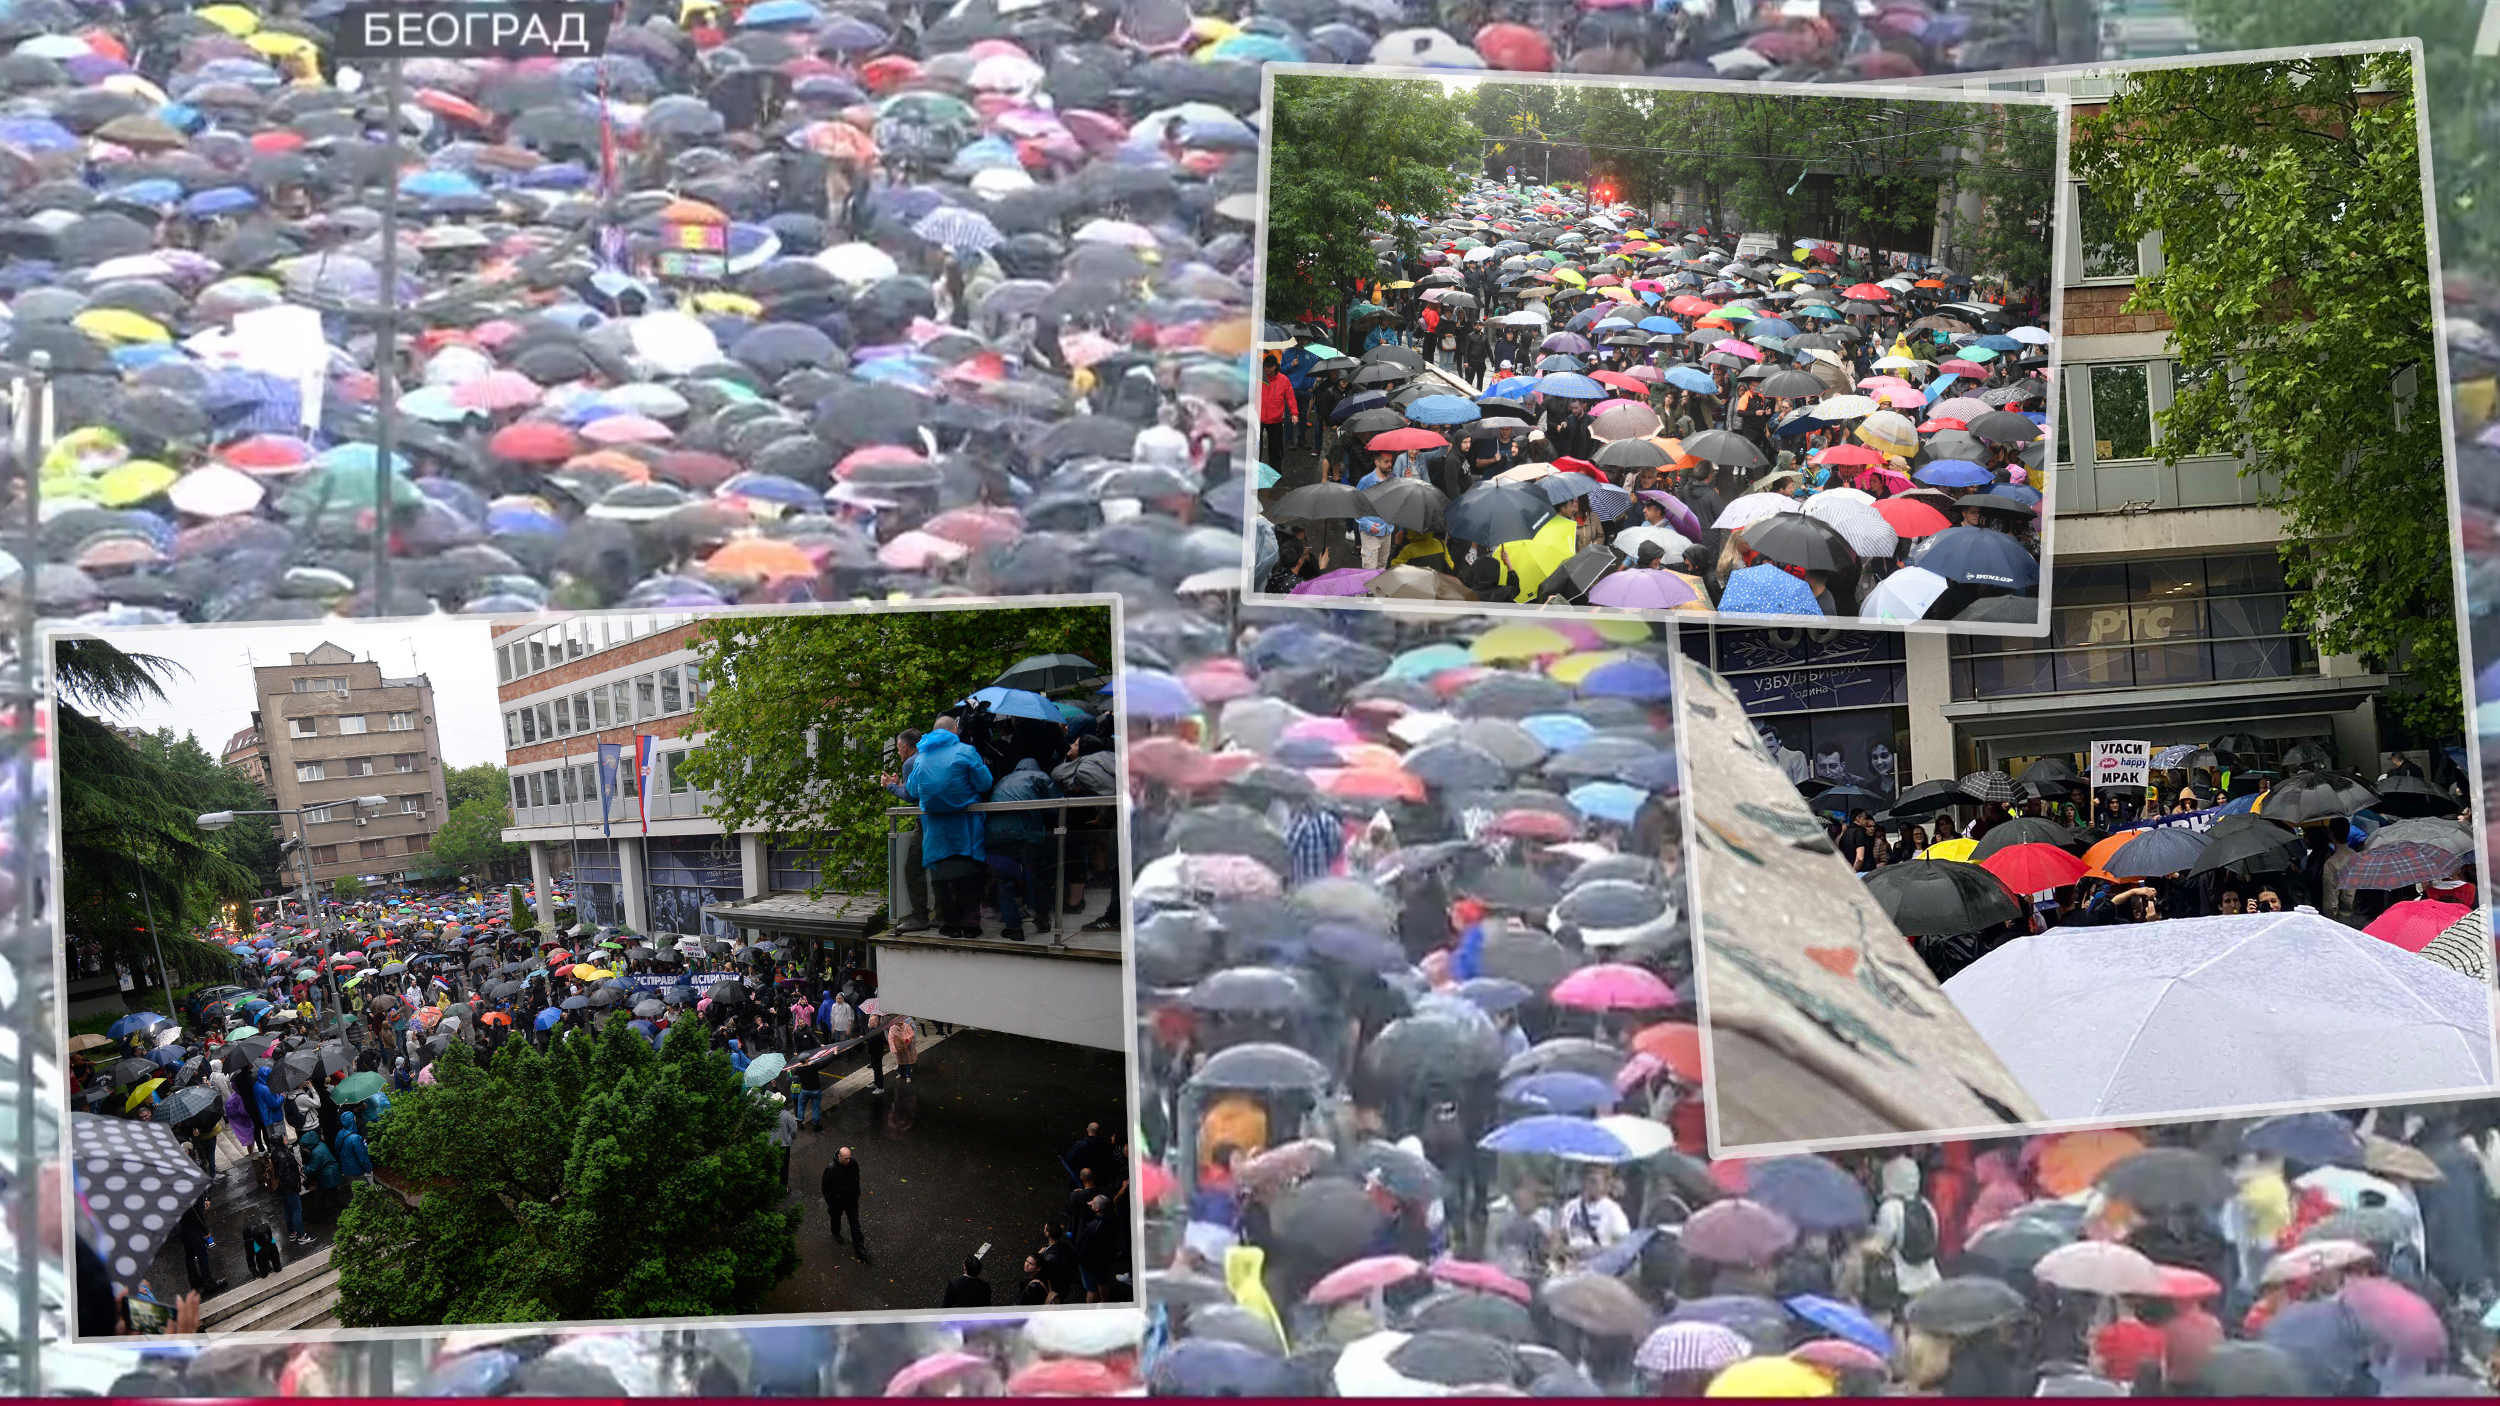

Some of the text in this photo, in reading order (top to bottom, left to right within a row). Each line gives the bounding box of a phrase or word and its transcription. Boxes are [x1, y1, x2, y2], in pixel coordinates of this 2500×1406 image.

[1976, 573, 2014, 583] DUNLOP
[2087, 606, 2174, 643] РТС
[1790, 685, 1829, 699] година
[2101, 743, 2143, 754] УГАСИ
[2121, 757, 2147, 768] happy
[2102, 772, 2139, 784] МРАК
